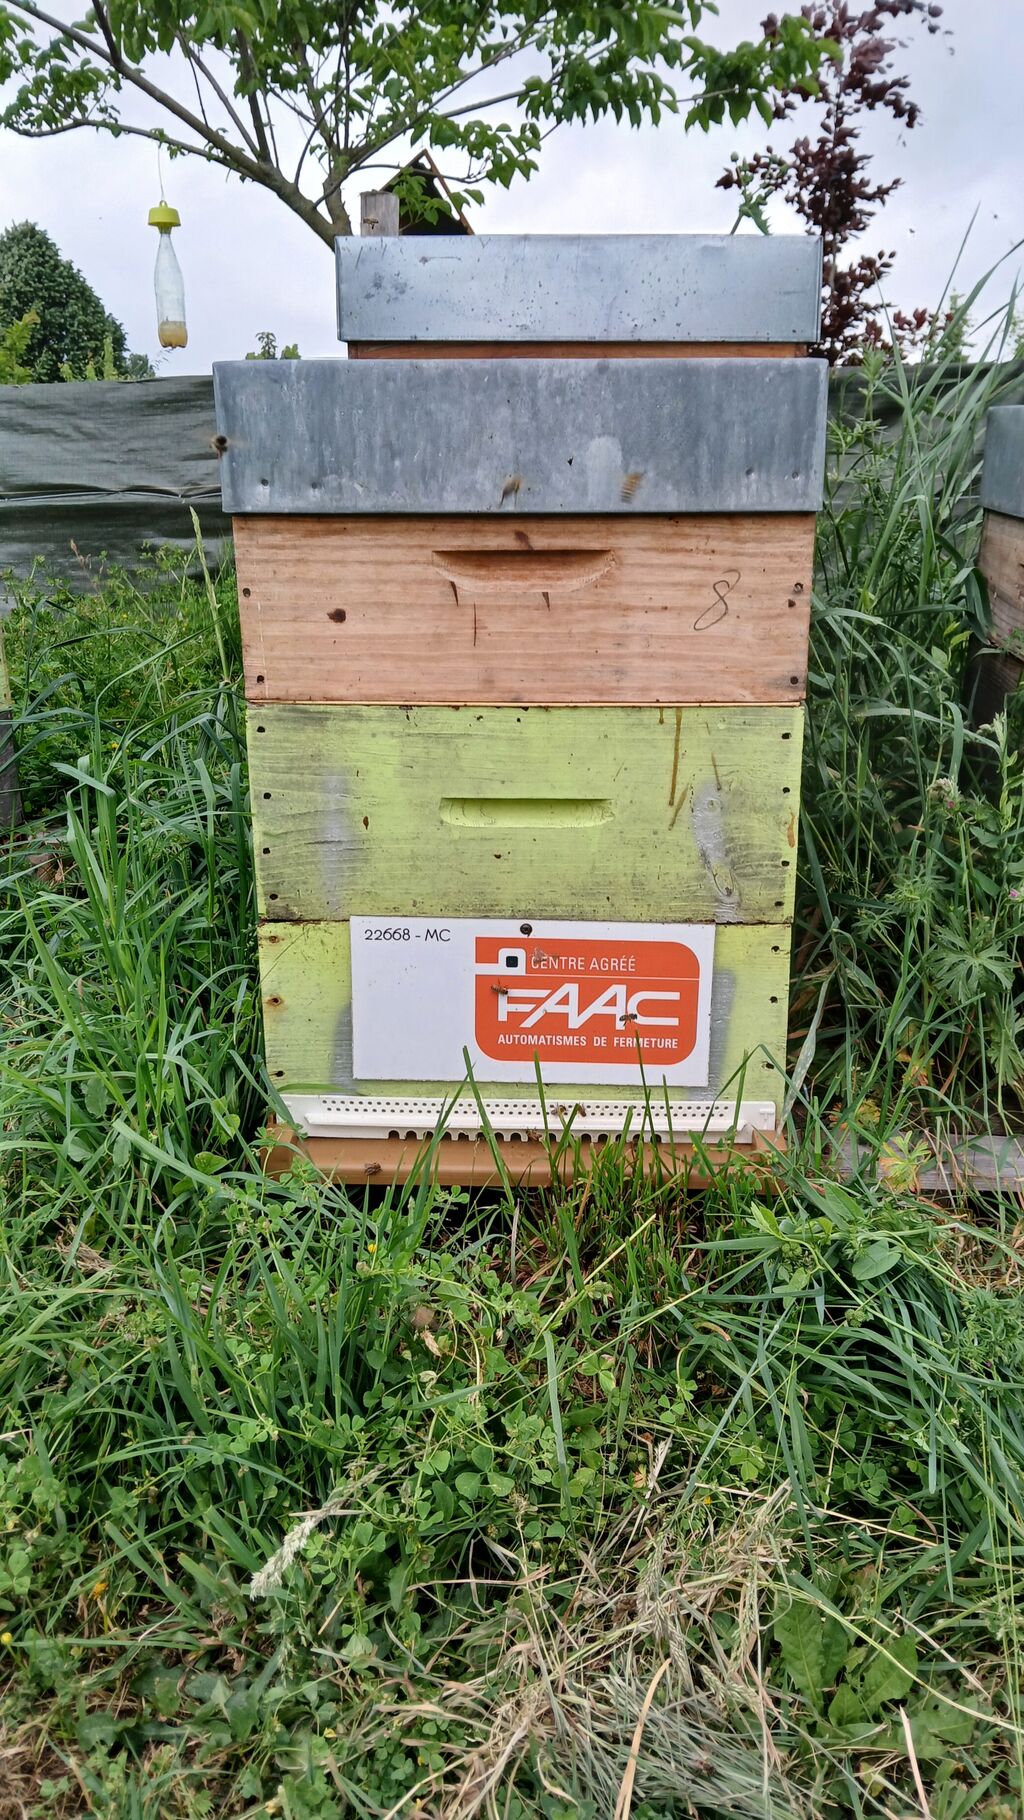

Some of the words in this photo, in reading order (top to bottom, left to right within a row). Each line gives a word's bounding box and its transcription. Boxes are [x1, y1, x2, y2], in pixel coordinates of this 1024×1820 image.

[693, 568, 742, 632] 8
[364, 927, 411, 941] 22668
[424, 928, 451, 942] MC
[531, 956, 586, 970] CENTRE
[589, 954, 636, 972] AGRÉÉ
[497, 982, 681, 1031] FAAC
[497, 1034, 587, 1047] AUTOMATISMES
[593, 1036, 608, 1047] DE
[613, 1036, 679, 1049] FERMETURE
